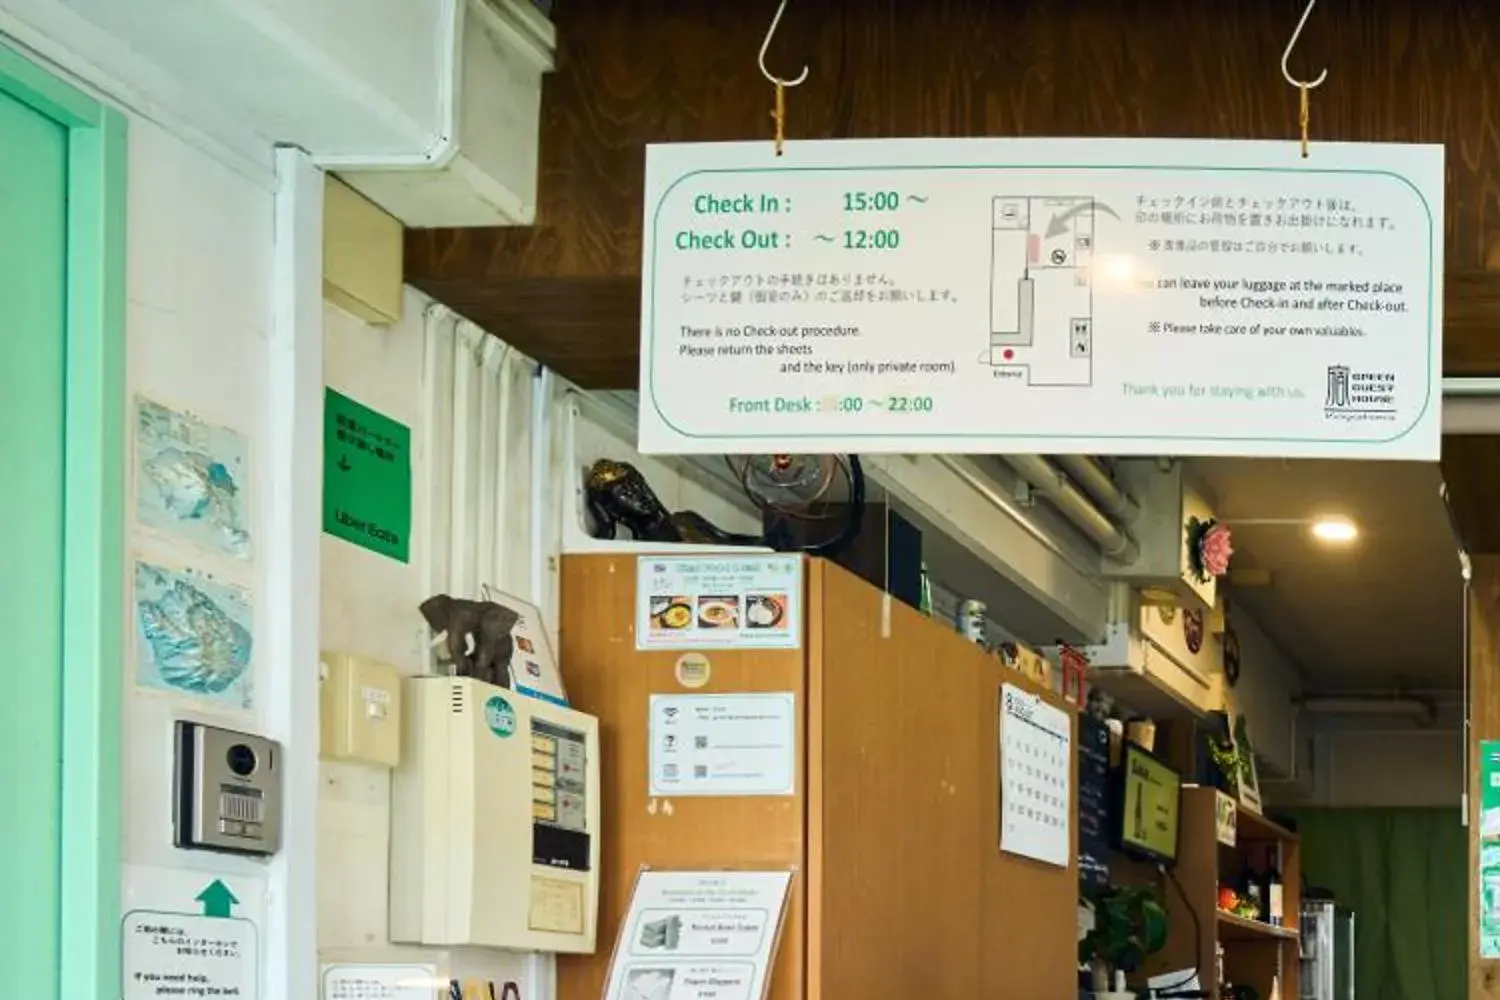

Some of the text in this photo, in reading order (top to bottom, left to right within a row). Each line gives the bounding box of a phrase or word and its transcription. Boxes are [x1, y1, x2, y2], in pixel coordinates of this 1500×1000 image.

[695, 194, 755, 213] Check
[761, 195, 779, 212] In
[843, 192, 898, 211] 15:00
[676, 230, 734, 250] Check
[741, 231, 778, 250] Out
[843, 231, 898, 249] 12:00
[1157, 279, 1177, 289] can
[1180, 278, 1210, 290] leave
[1213, 281, 1240, 292] your
[1242, 278, 1287, 292] luggage
[1289, 280, 1301, 291] at
[1304, 279, 1323, 291] the
[1326, 280, 1370, 293] marked
[1372, 282, 1403, 295] place
[1200, 297, 1237, 309] before
[1292, 298, 1314, 310] and
[1317, 298, 1345, 311] after
[681, 325, 711, 338] There
[714, 325, 723, 338] is
[725, 328, 741, 338] no
[1163, 321, 1197, 334] Please
[1199, 321, 1222, 334] take
[1223, 325, 1247, 335] care
[1249, 322, 1261, 335] of
[1263, 326, 1287, 338] your
[1289, 326, 1312, 336] own
[680, 344, 813, 357] Please return the sheets
[780, 360, 801, 373] and
[804, 360, 823, 373] the
[825, 360, 844, 376] key
[878, 360, 917, 376] private
[1123, 382, 1158, 397] Thank
[1161, 386, 1183, 402] you
[1189, 383, 1207, 398] for
[1210, 383, 1255, 402] staying
[1257, 383, 1286, 398] with
[729, 397, 770, 413] Front
[774, 397, 811, 413] Desk
[888, 396, 934, 413] 22:00
